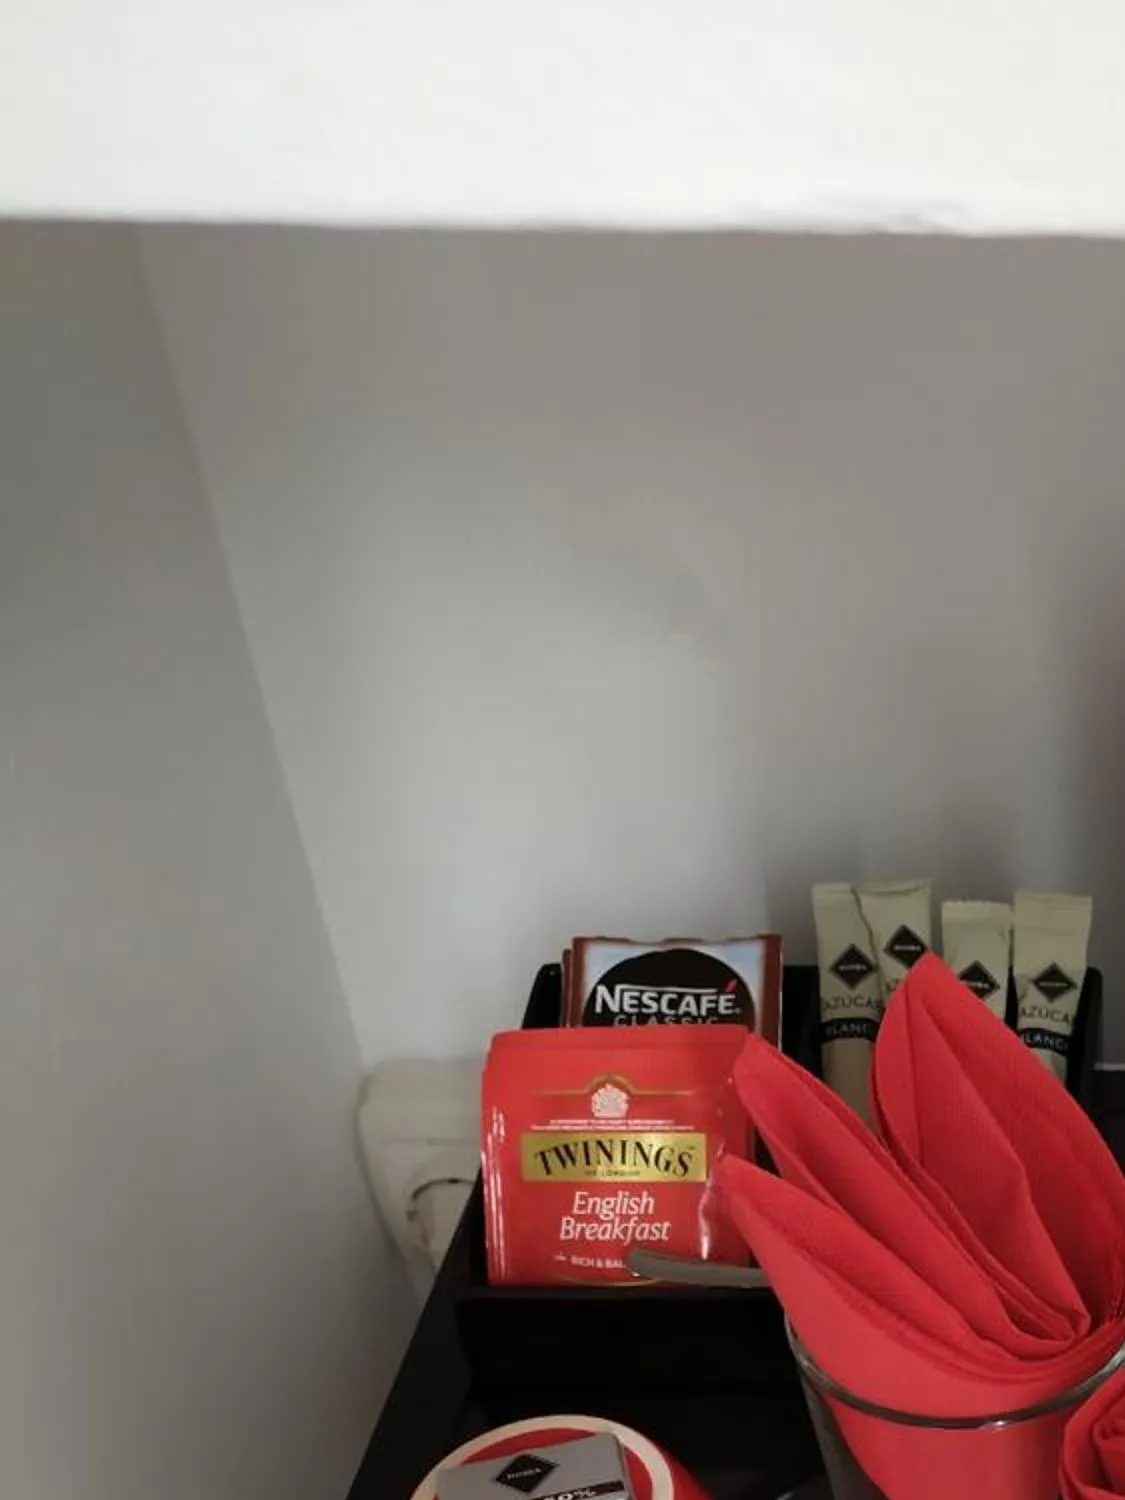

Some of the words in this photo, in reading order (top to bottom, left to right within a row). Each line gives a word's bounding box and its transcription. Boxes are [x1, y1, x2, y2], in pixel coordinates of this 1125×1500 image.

[595, 980, 737, 1016] NESCAFÉ
[534, 1138, 693, 1178] TWININGS
[573, 1190, 655, 1221] English
[560, 1216, 672, 1246] Breakfast
